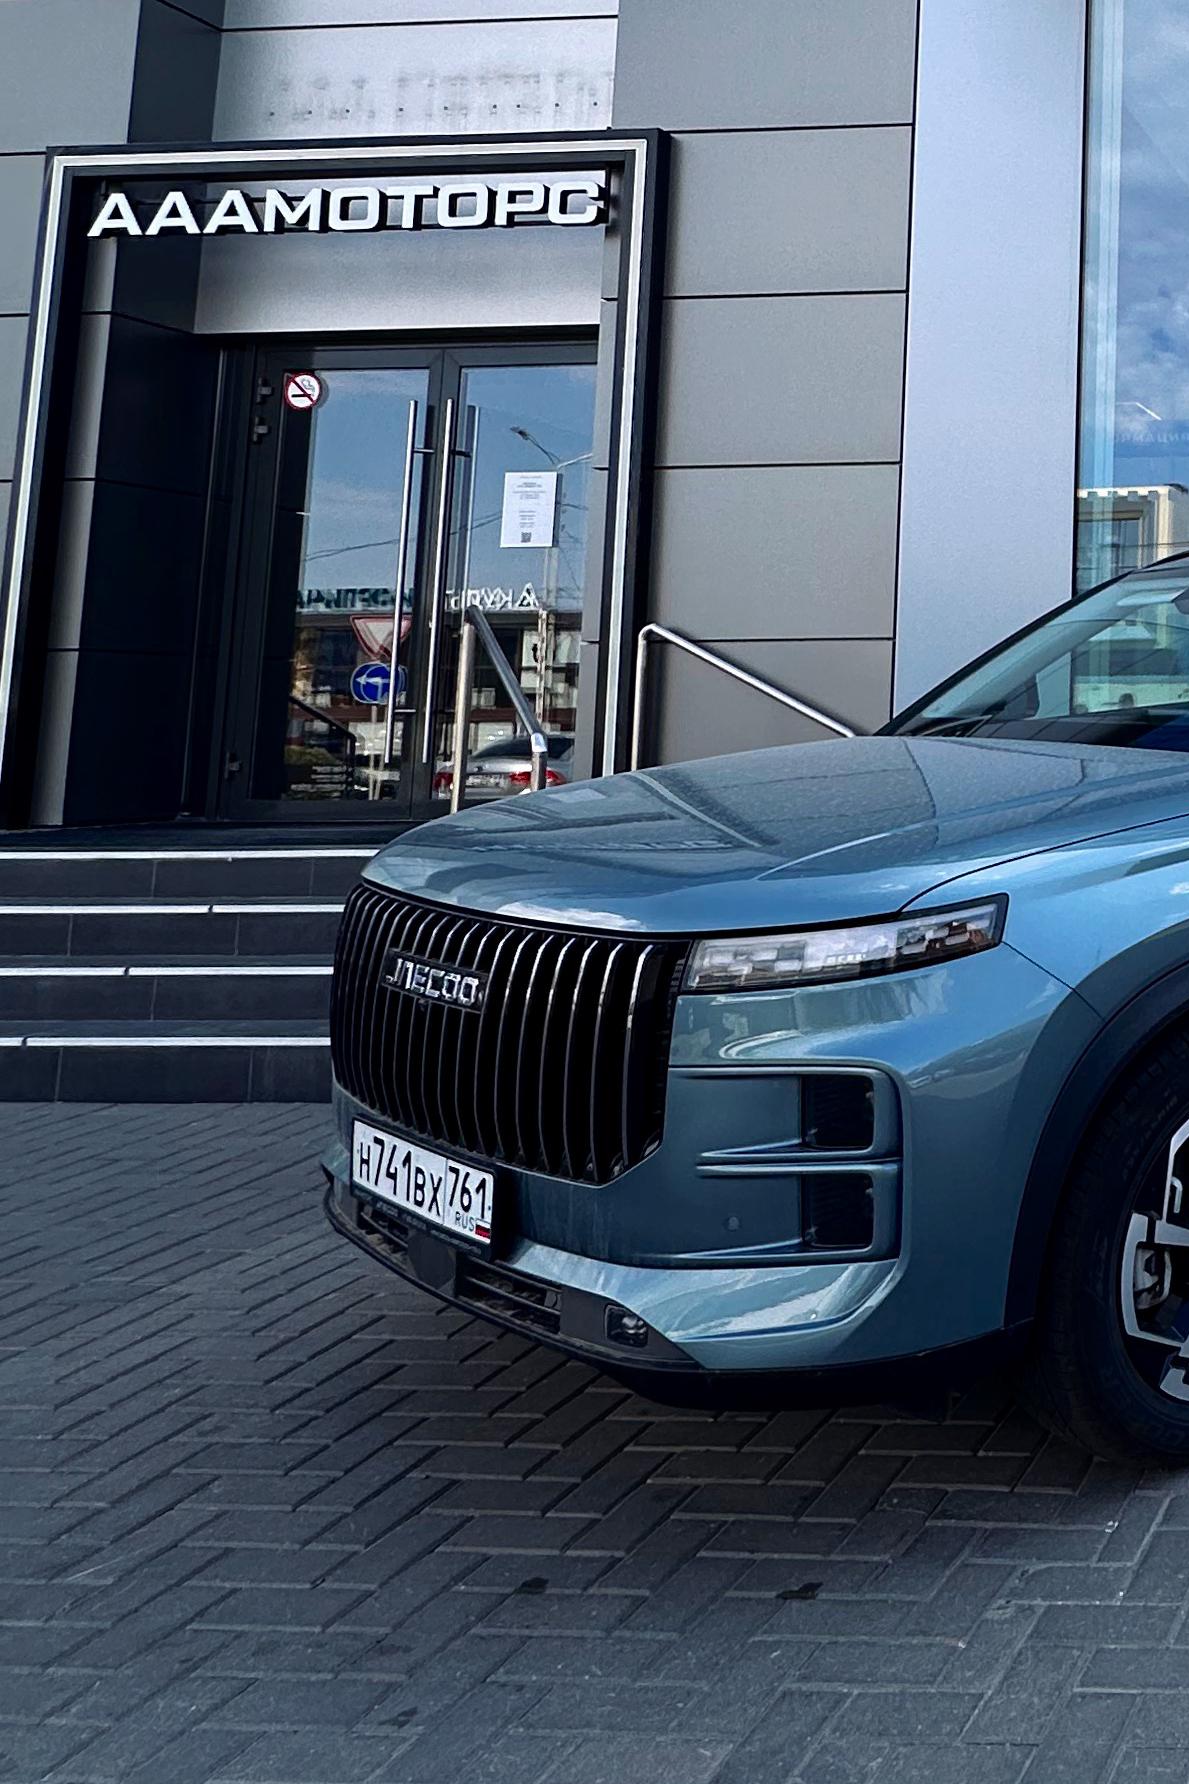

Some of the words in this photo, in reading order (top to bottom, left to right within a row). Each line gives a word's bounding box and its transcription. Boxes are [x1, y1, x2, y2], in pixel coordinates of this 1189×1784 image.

[385, 958, 479, 1005] JAECOO
[448, 1166, 487, 1219] 761
[454, 1211, 474, 1231] RUS
